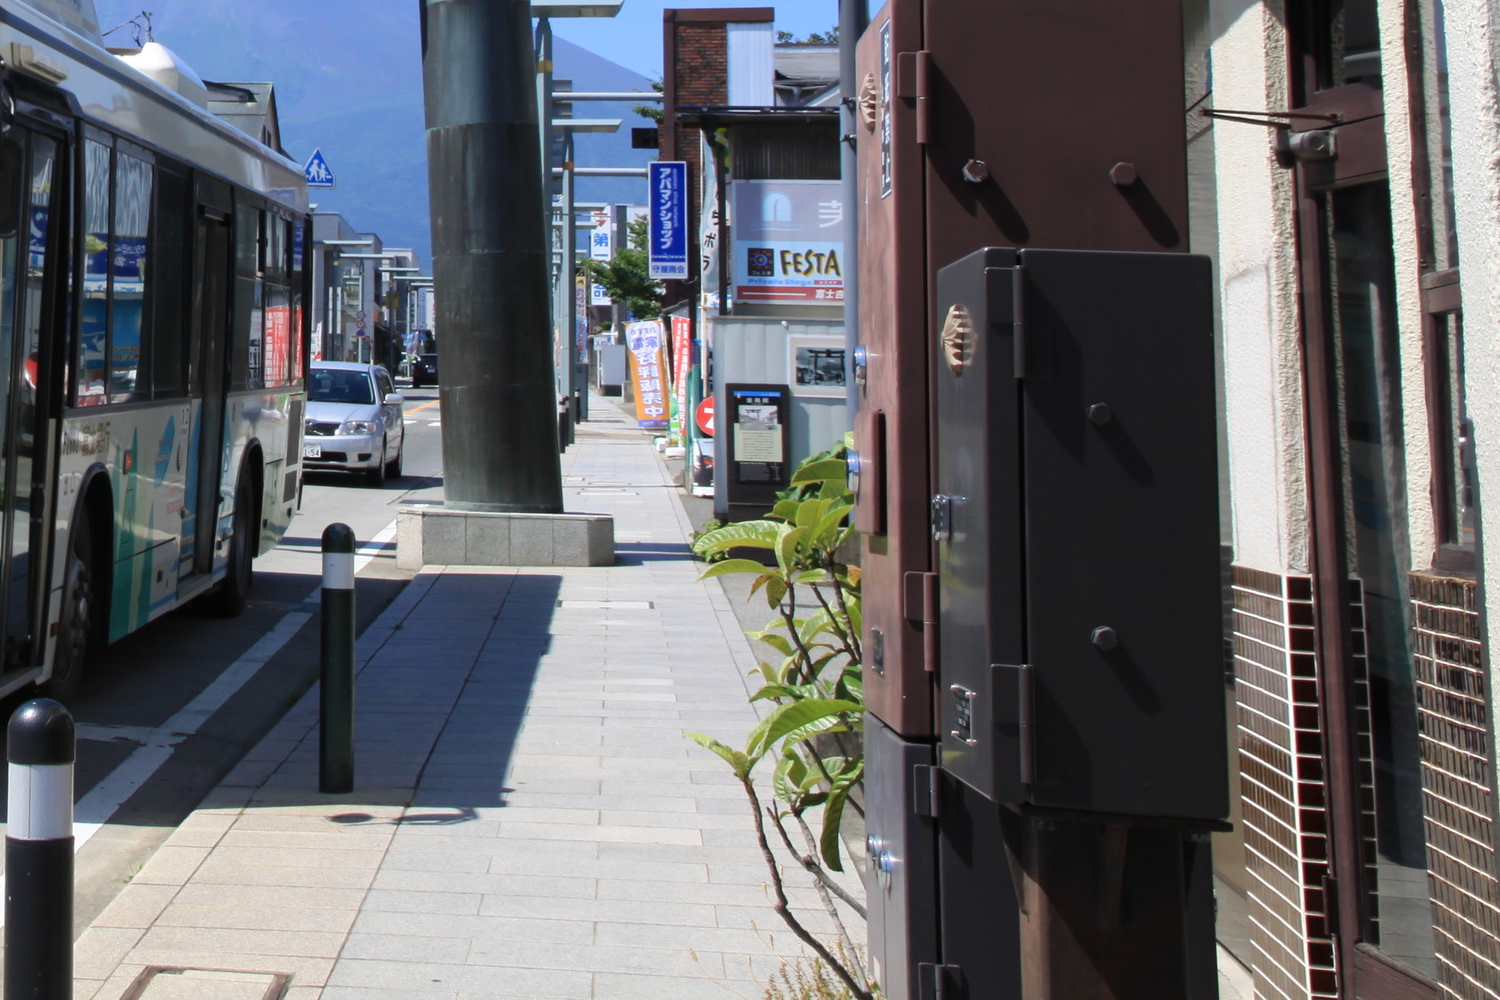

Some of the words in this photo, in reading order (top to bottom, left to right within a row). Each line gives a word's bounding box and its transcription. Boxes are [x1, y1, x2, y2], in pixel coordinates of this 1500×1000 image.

[659, 167, 674, 249] アパマンショップ
[779, 248, 842, 277] FESTA
